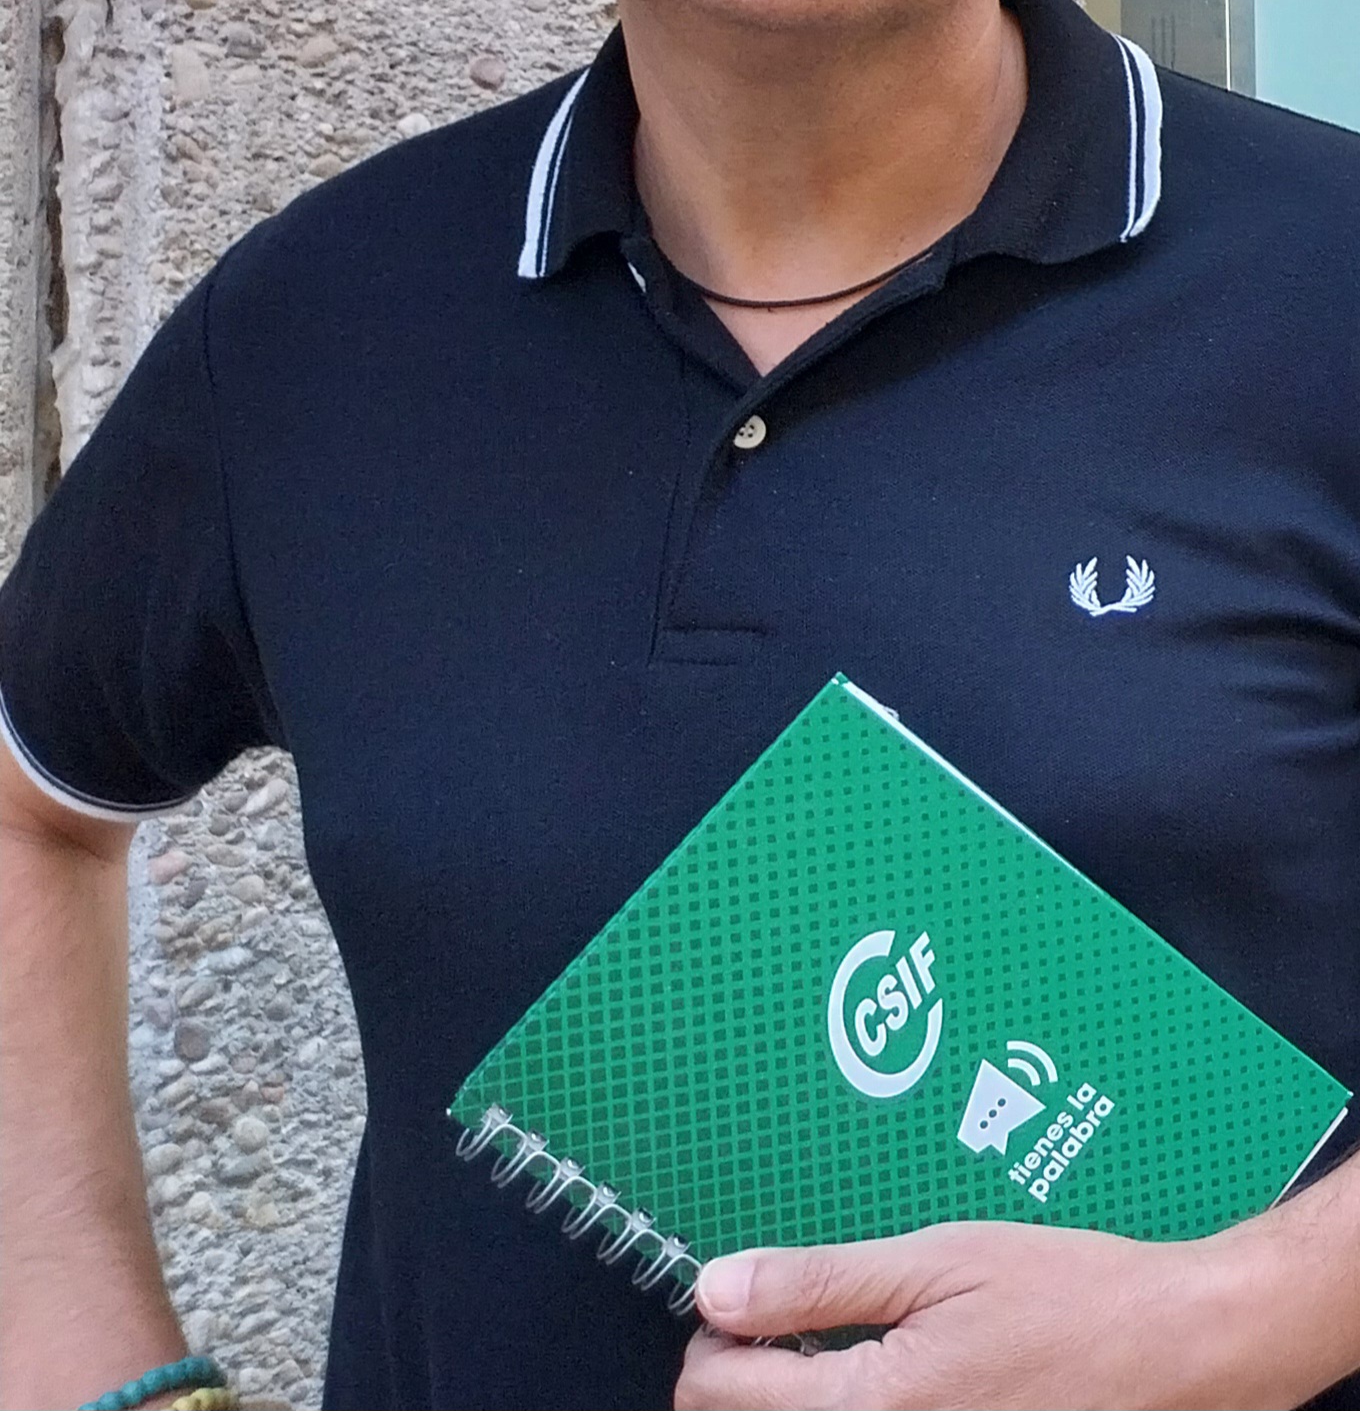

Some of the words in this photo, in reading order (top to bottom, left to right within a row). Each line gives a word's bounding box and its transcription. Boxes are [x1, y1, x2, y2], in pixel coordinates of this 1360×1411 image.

[855, 931, 936, 1057] CSIF
[1008, 1112, 1074, 1187] tienes
[1067, 1082, 1097, 1112] la
[1027, 1095, 1115, 1204] palabra
